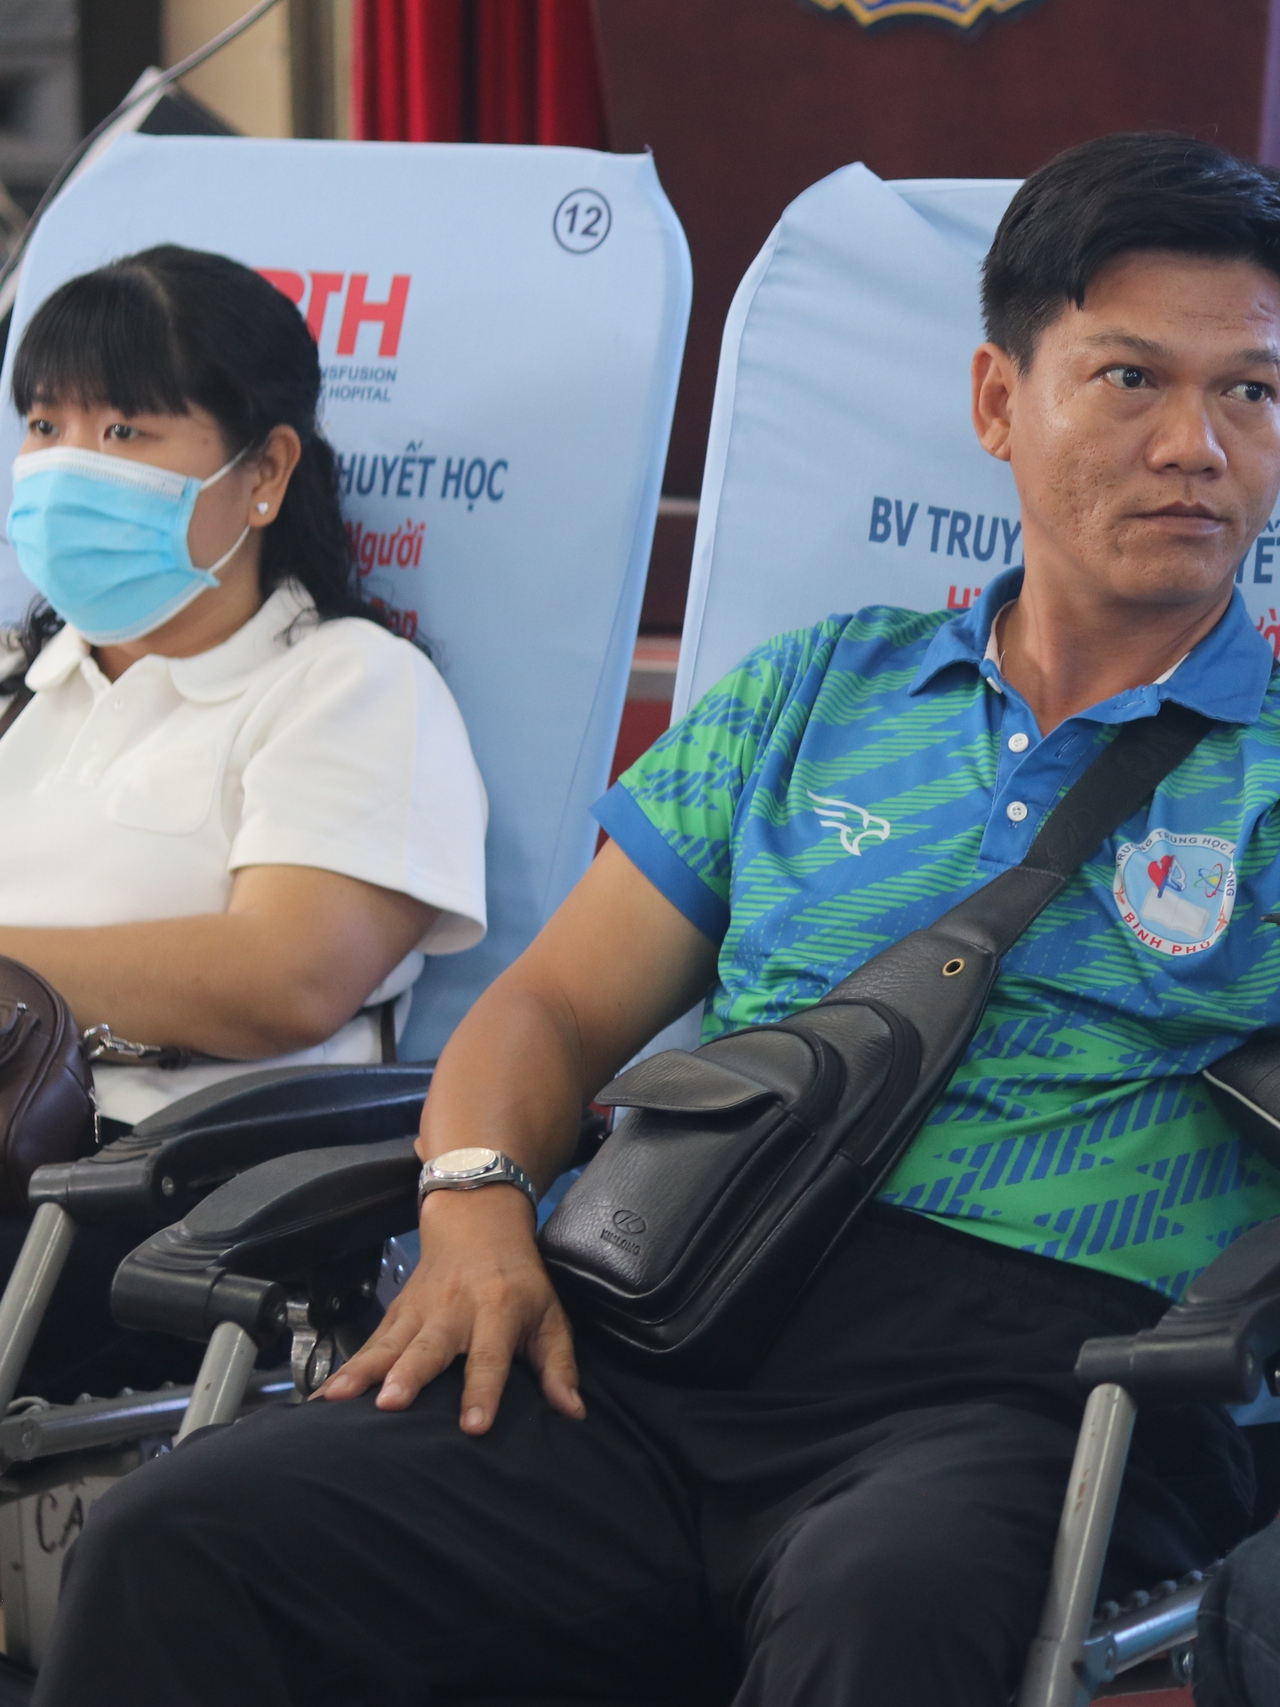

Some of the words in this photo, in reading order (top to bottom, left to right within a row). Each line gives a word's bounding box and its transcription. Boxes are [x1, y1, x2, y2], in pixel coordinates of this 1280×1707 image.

[565, 202, 602, 237] 12
[441, 455, 508, 512] HỌC
[868, 495, 920, 547] BV
[927, 505, 1024, 566] TRUY
[1202, 837, 1228, 851] HỌC
